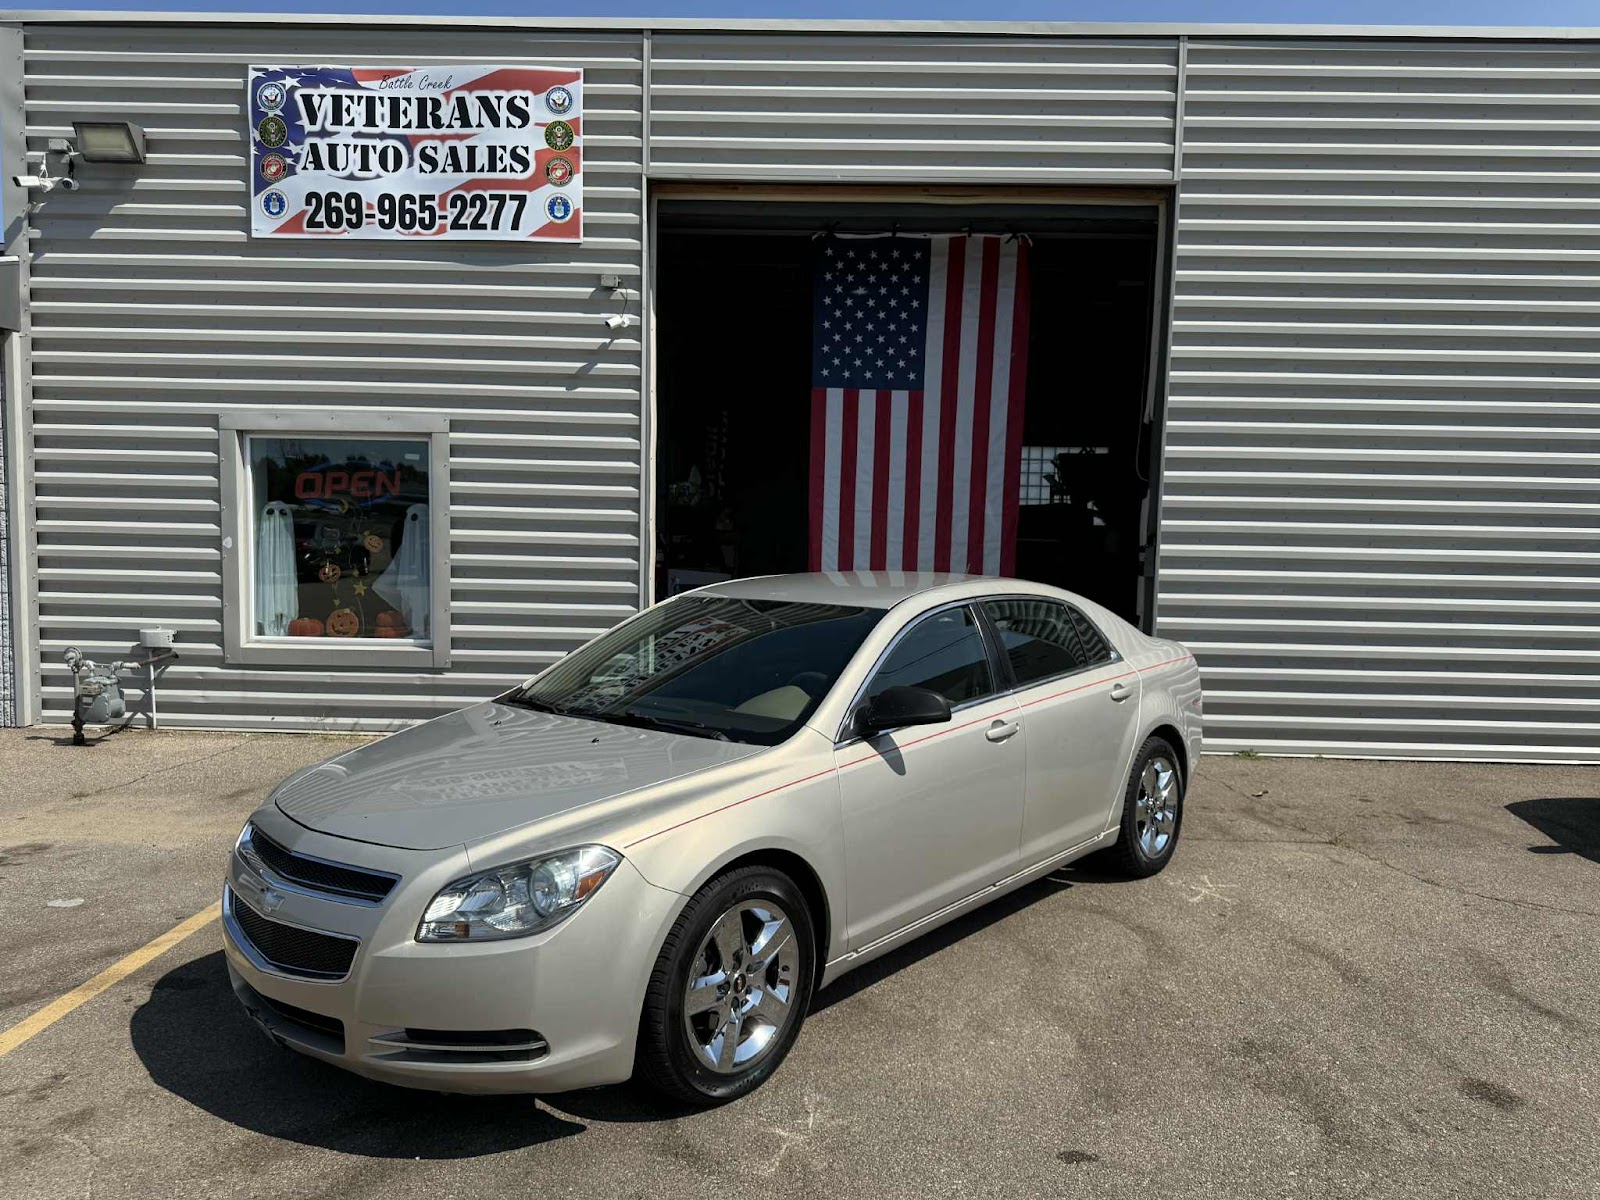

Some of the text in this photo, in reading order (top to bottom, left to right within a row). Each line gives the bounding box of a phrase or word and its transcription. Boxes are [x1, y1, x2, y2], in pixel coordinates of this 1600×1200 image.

[378, 74, 453, 91] Battle Creek
[300, 93, 531, 130] VETERANS
[301, 141, 404, 172] AUTO
[419, 145, 531, 174] SALES
[305, 191, 528, 231] 269-965-2277
[295, 470, 401, 499] OPEN
